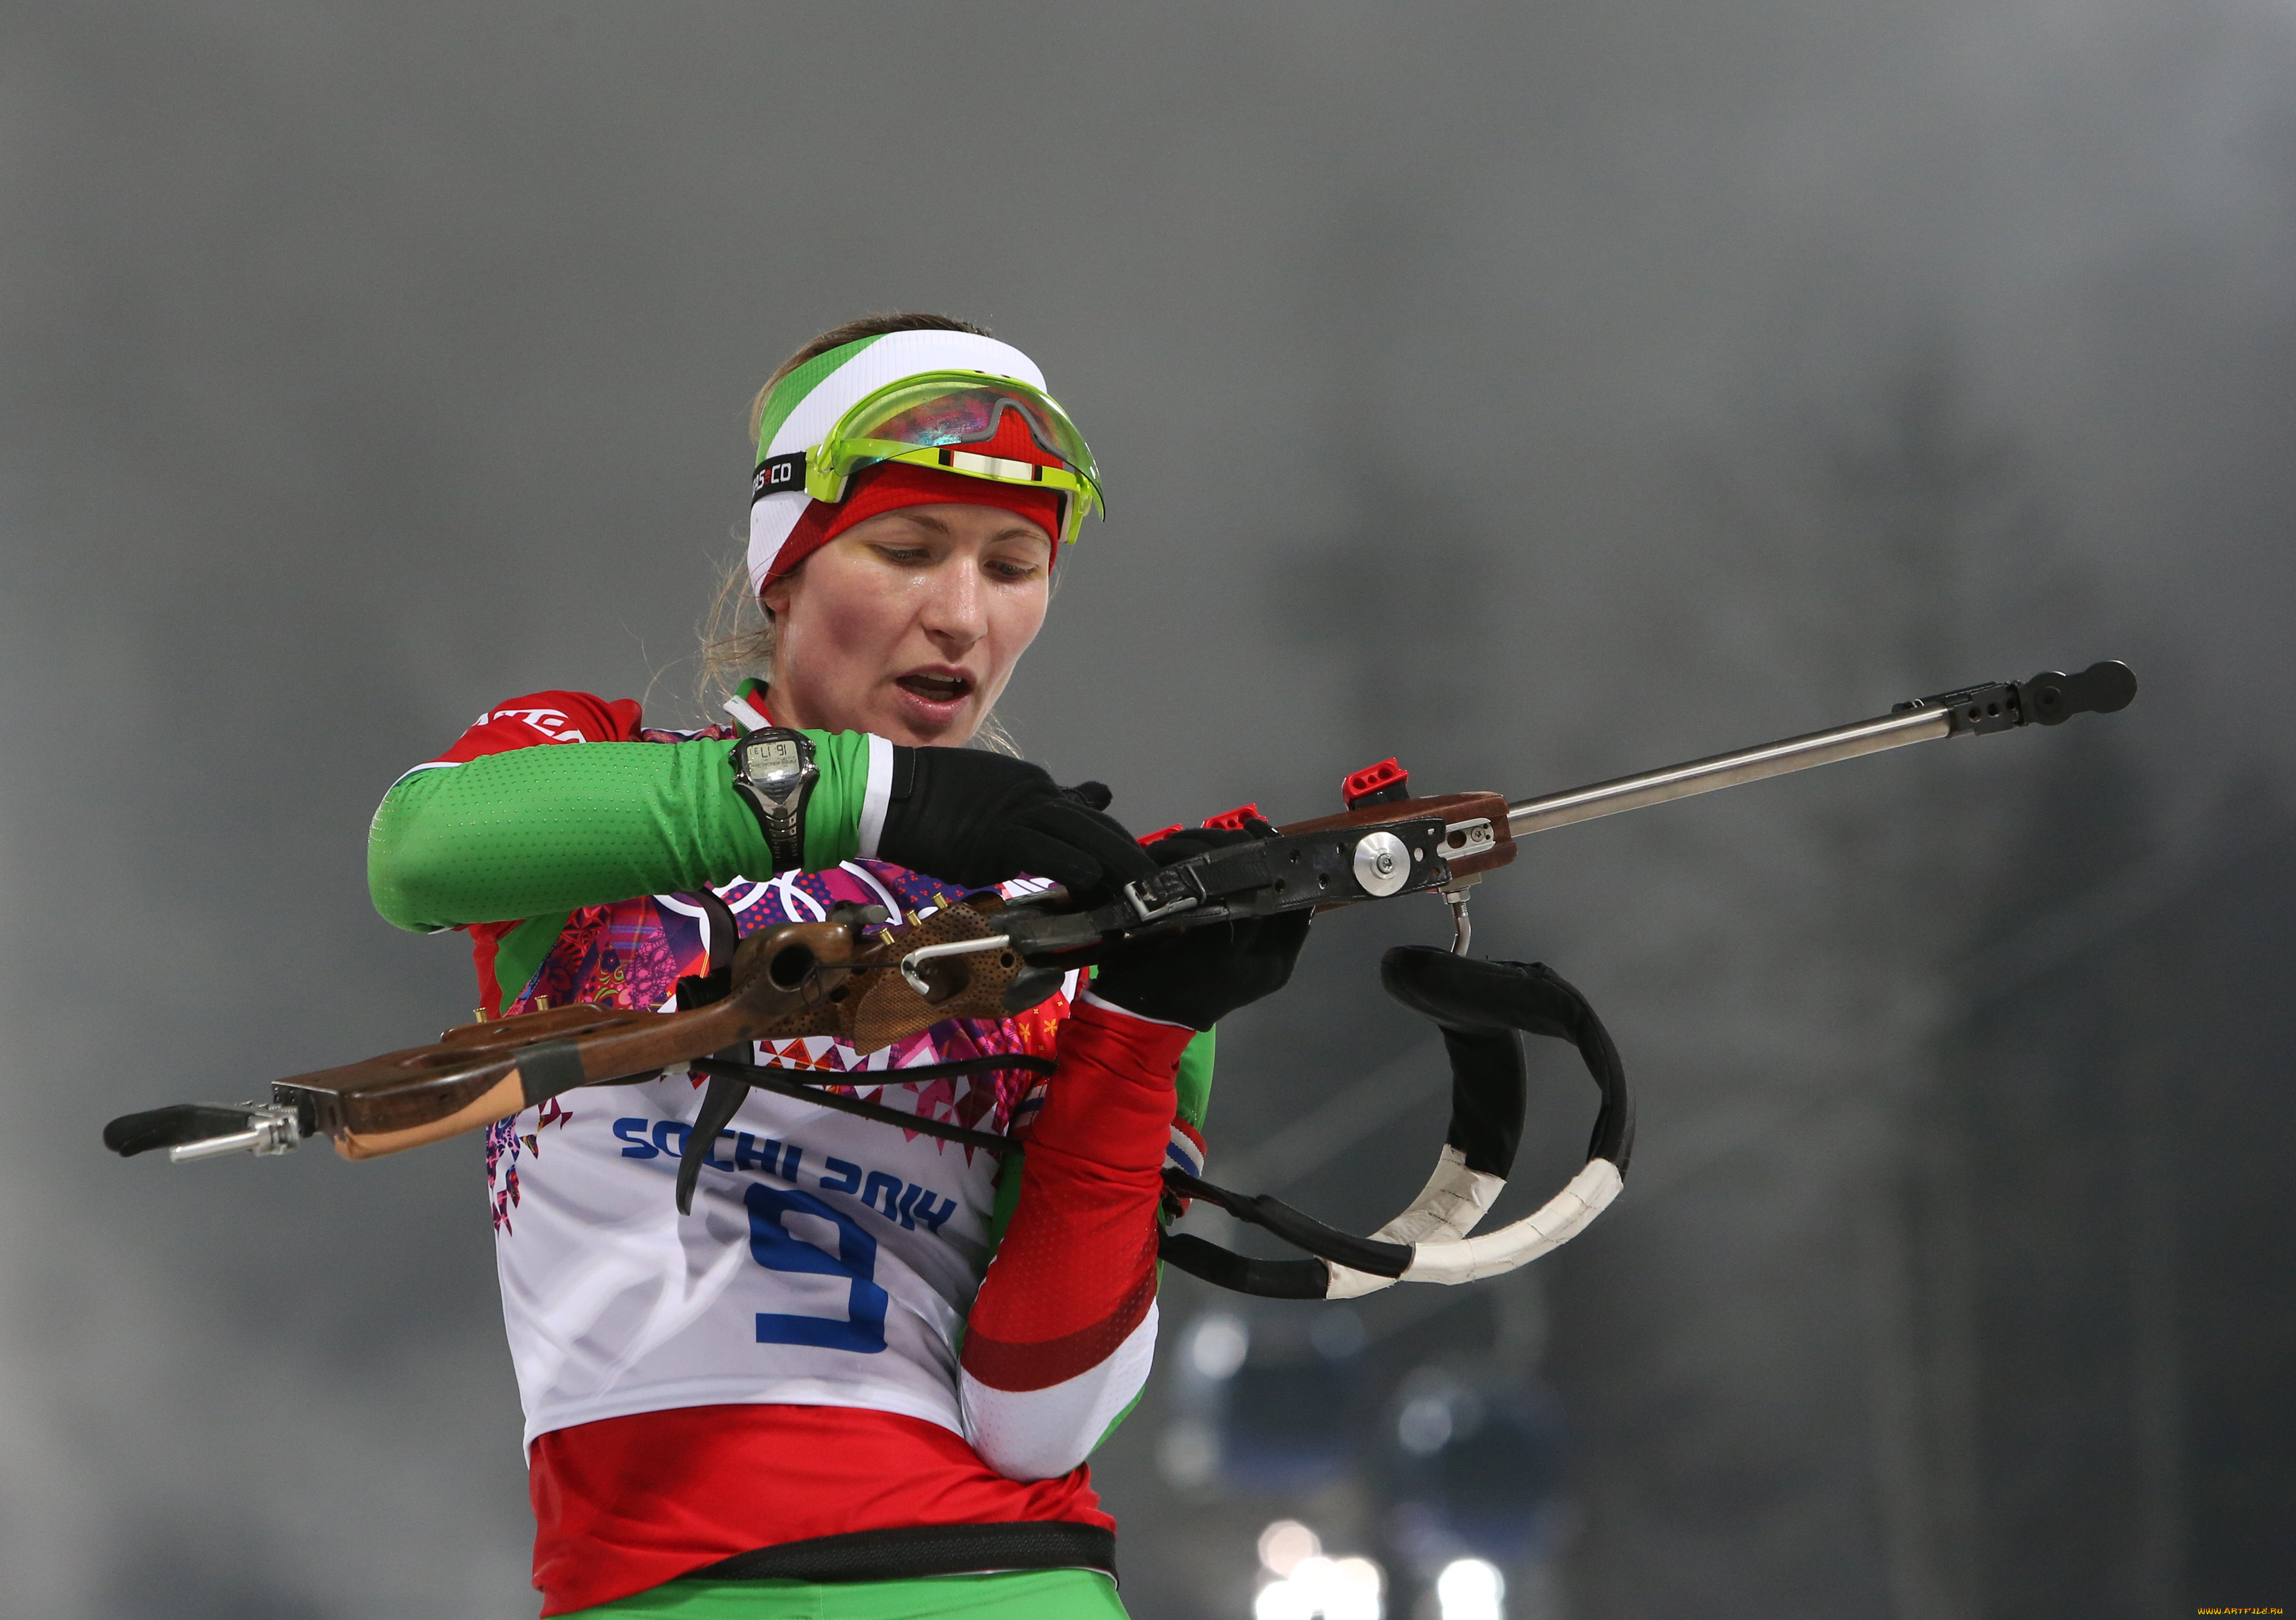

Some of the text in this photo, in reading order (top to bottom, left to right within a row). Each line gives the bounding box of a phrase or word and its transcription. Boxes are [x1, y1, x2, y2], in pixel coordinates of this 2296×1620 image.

[612, 1117, 958, 1236] SOCHI 2014
[743, 1182, 889, 1354] 9
